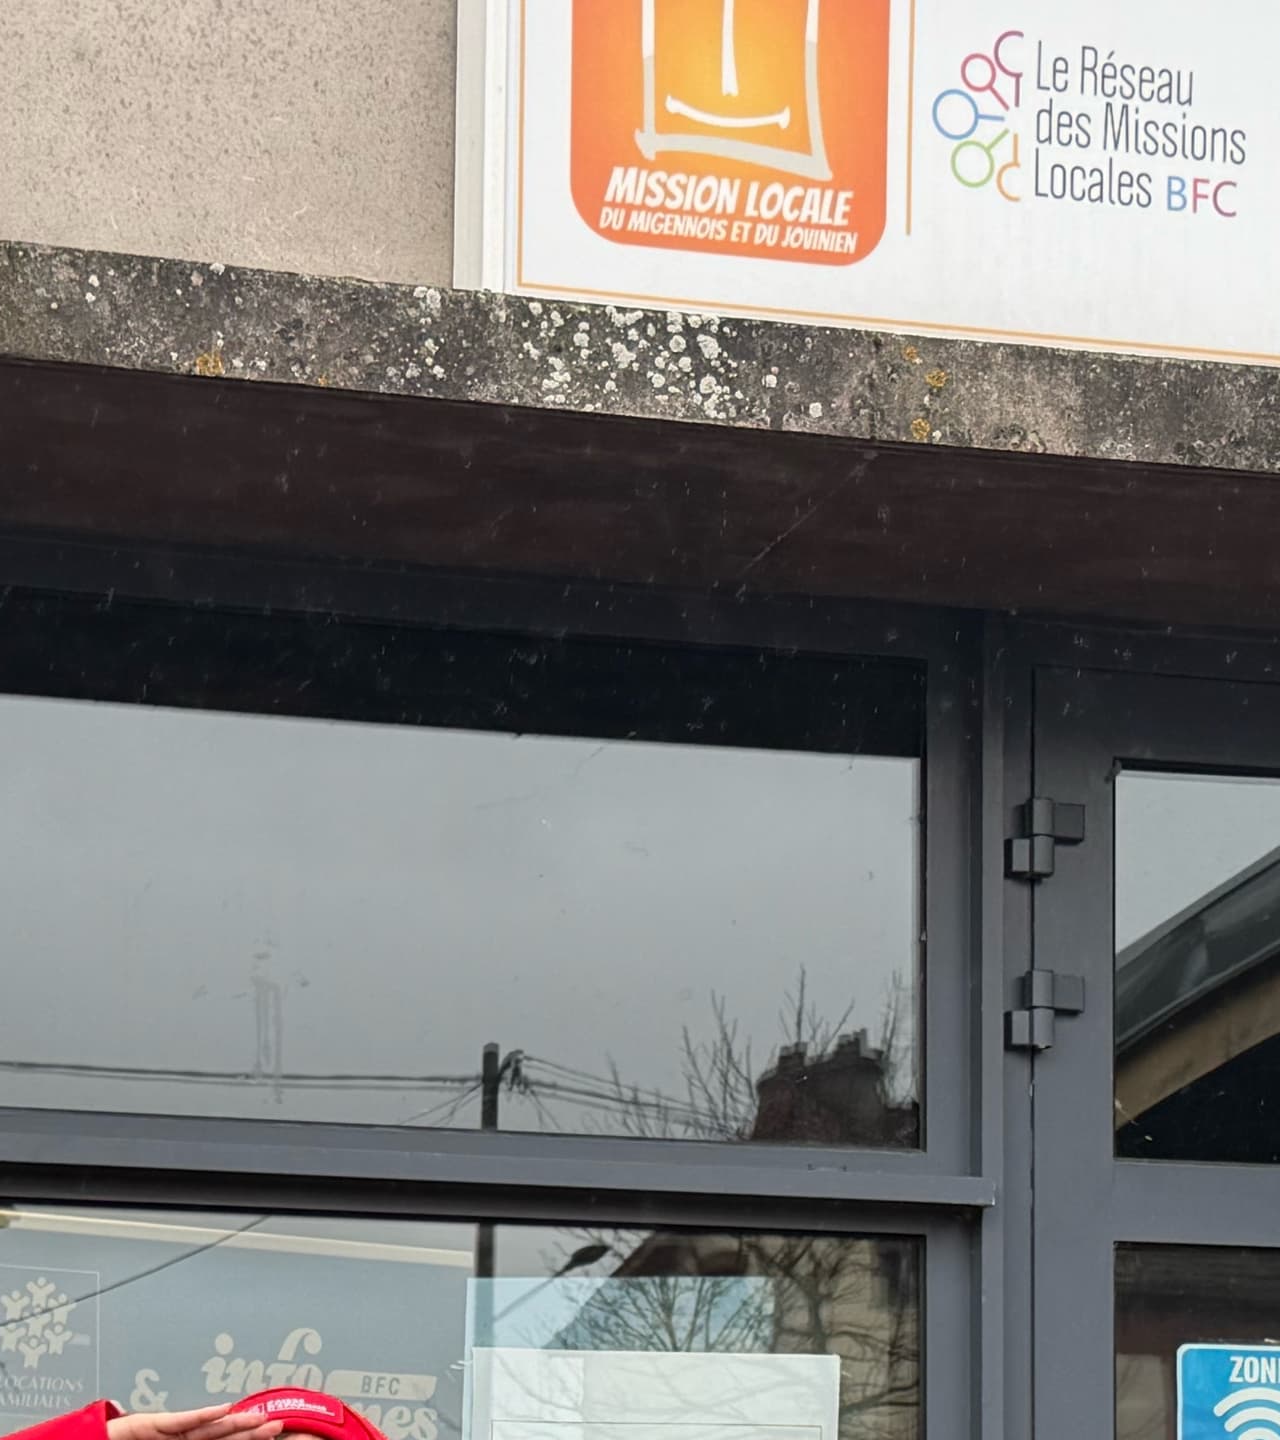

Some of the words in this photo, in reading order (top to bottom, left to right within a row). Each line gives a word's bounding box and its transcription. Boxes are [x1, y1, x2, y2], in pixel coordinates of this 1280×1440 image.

[1036, 40, 1069, 92] Le
[1080, 44, 1194, 107] Réseau
[1036, 104, 1092, 149] des
[1102, 103, 1246, 166] Missions
[604, 166, 738, 216] MISSION
[743, 181, 851, 227] LOCALE
[1034, 148, 1154, 209] Locales
[1165, 175, 1238, 218] BFC
[598, 208, 624, 232] DU
[627, 211, 727, 243] MIGENNOIS
[730, 221, 750, 245] ET
[753, 223, 778, 247] DU
[780, 226, 857, 255] JOVINIEN
[361, 1375, 401, 1395] BFC
